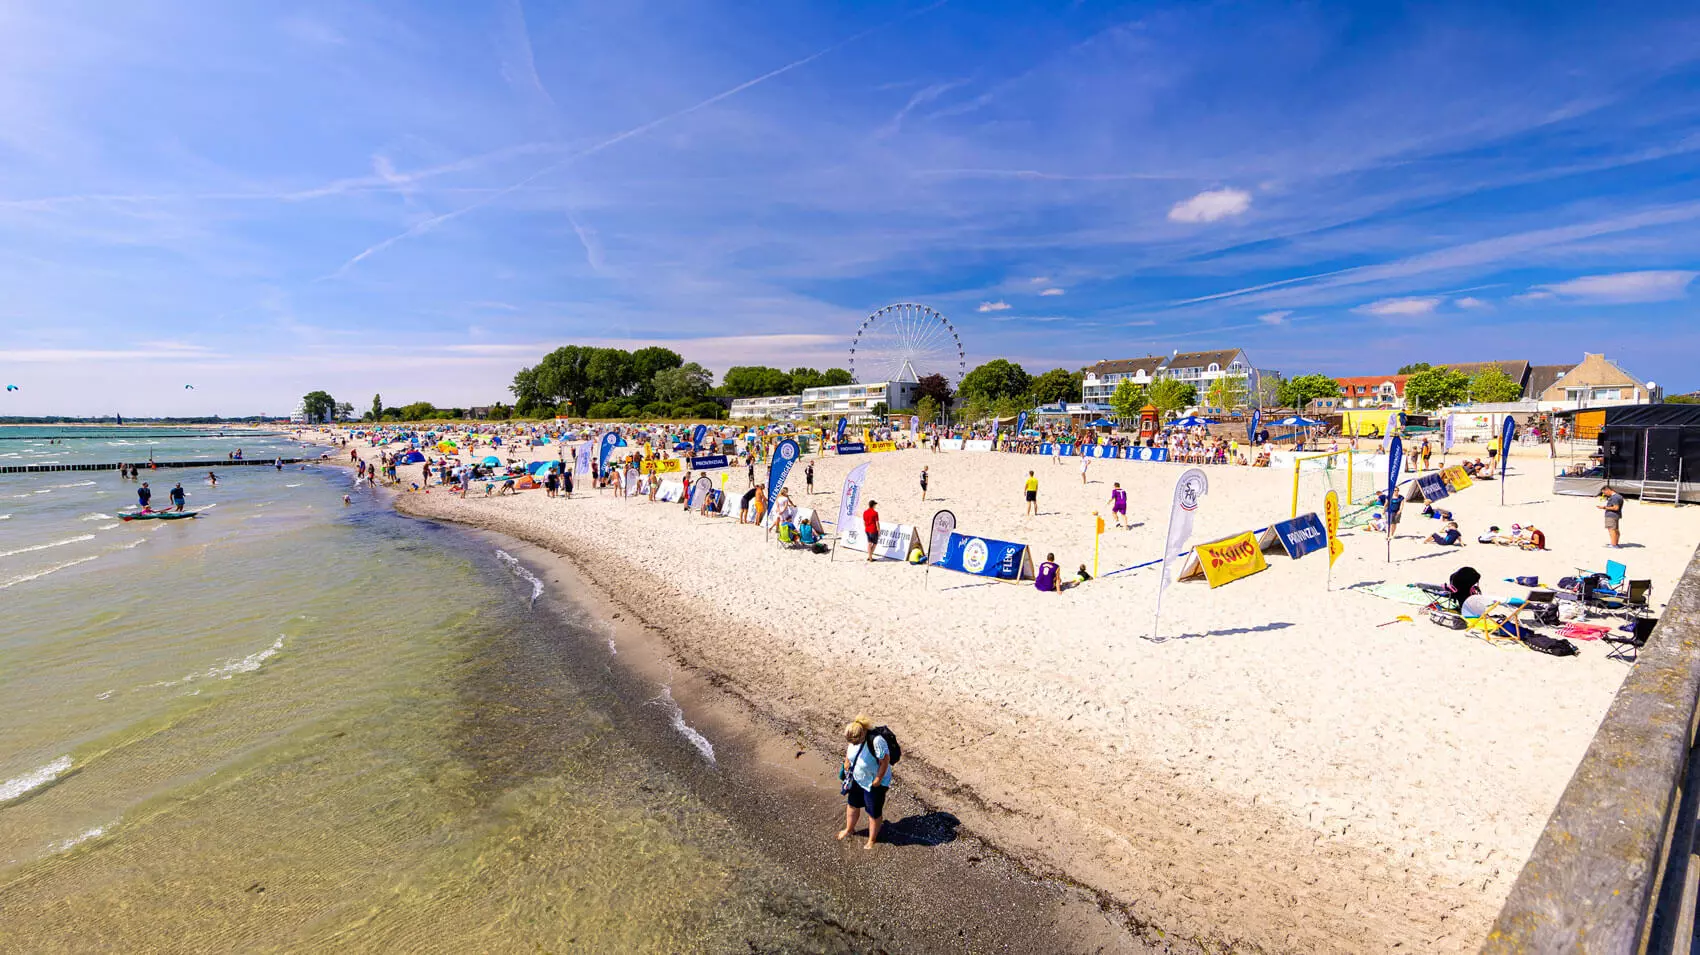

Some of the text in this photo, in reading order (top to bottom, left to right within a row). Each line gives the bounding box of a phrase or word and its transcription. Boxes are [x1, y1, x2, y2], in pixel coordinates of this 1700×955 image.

[769, 460, 794, 503] FLENSBURGER
[1287, 526, 1321, 545] PROVINZIAL
[1003, 547, 1016, 573] FLENS
[1221, 540, 1255, 563] LOTTO
